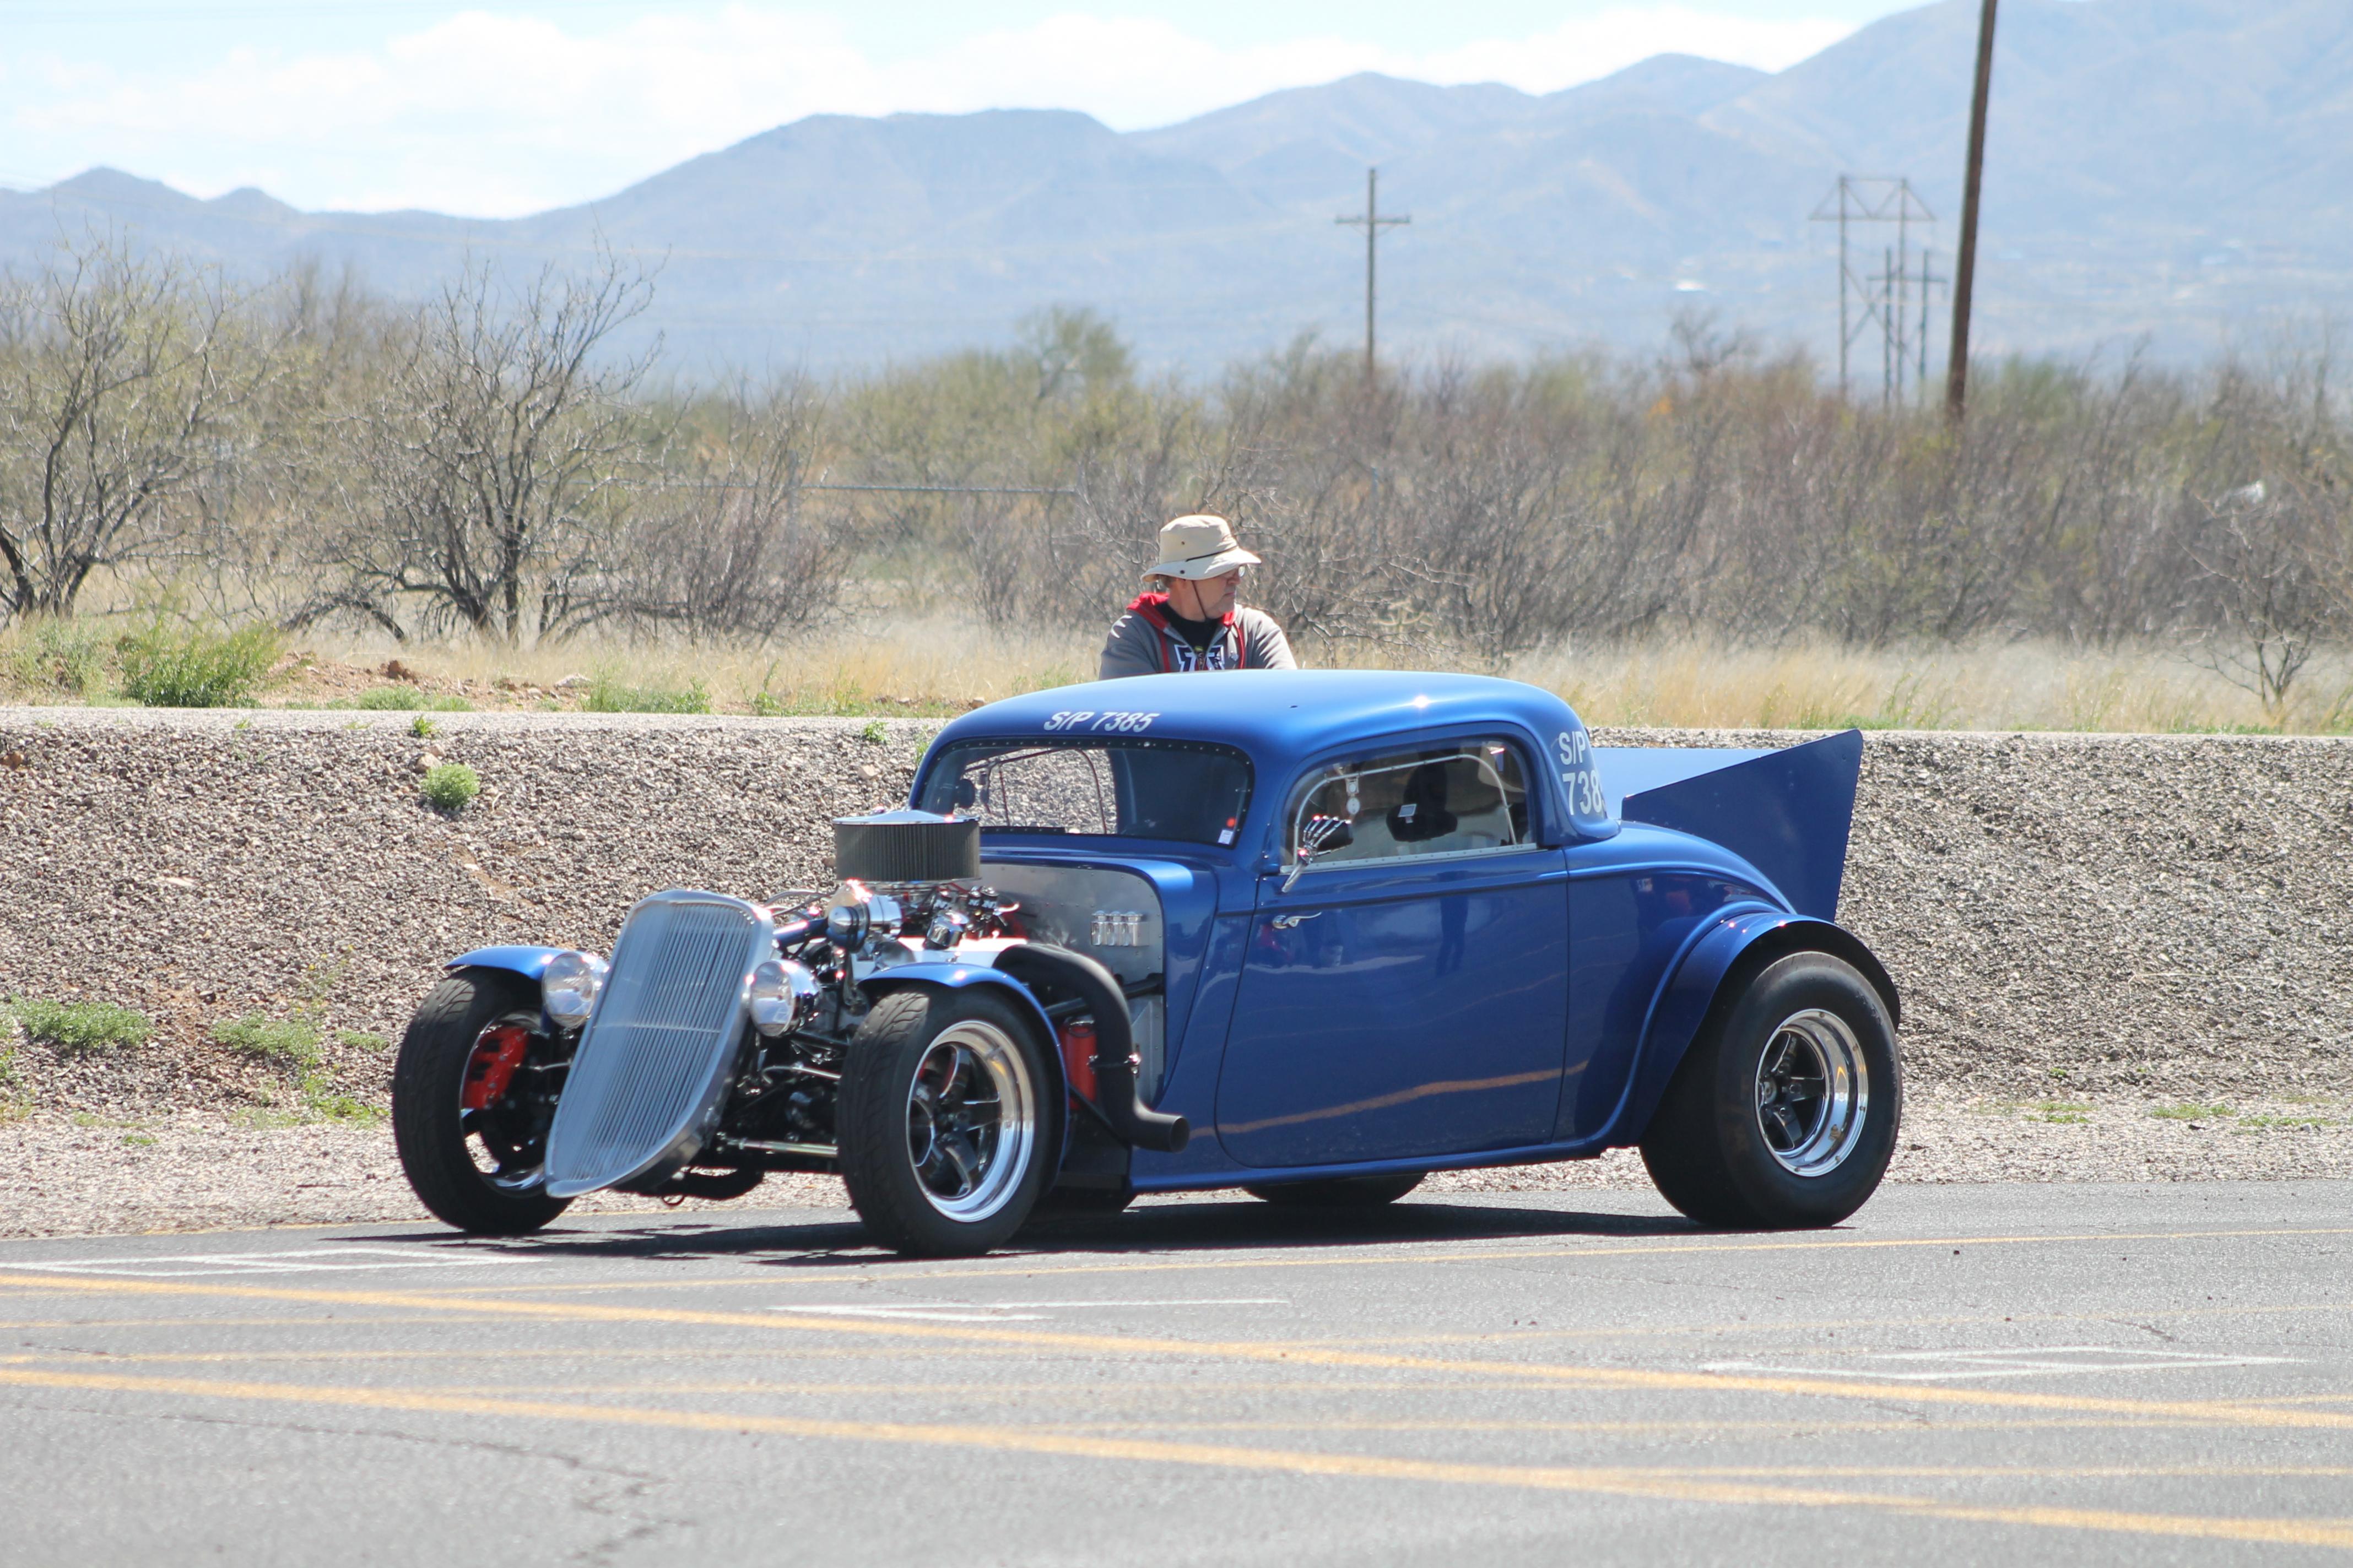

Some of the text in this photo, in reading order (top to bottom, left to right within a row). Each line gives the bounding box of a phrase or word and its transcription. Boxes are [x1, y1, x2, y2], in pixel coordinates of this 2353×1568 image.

[1043, 712, 1161, 733] S/P 7385
[1559, 731, 1586, 765] S/P
[1562, 770, 1604, 815] 738
